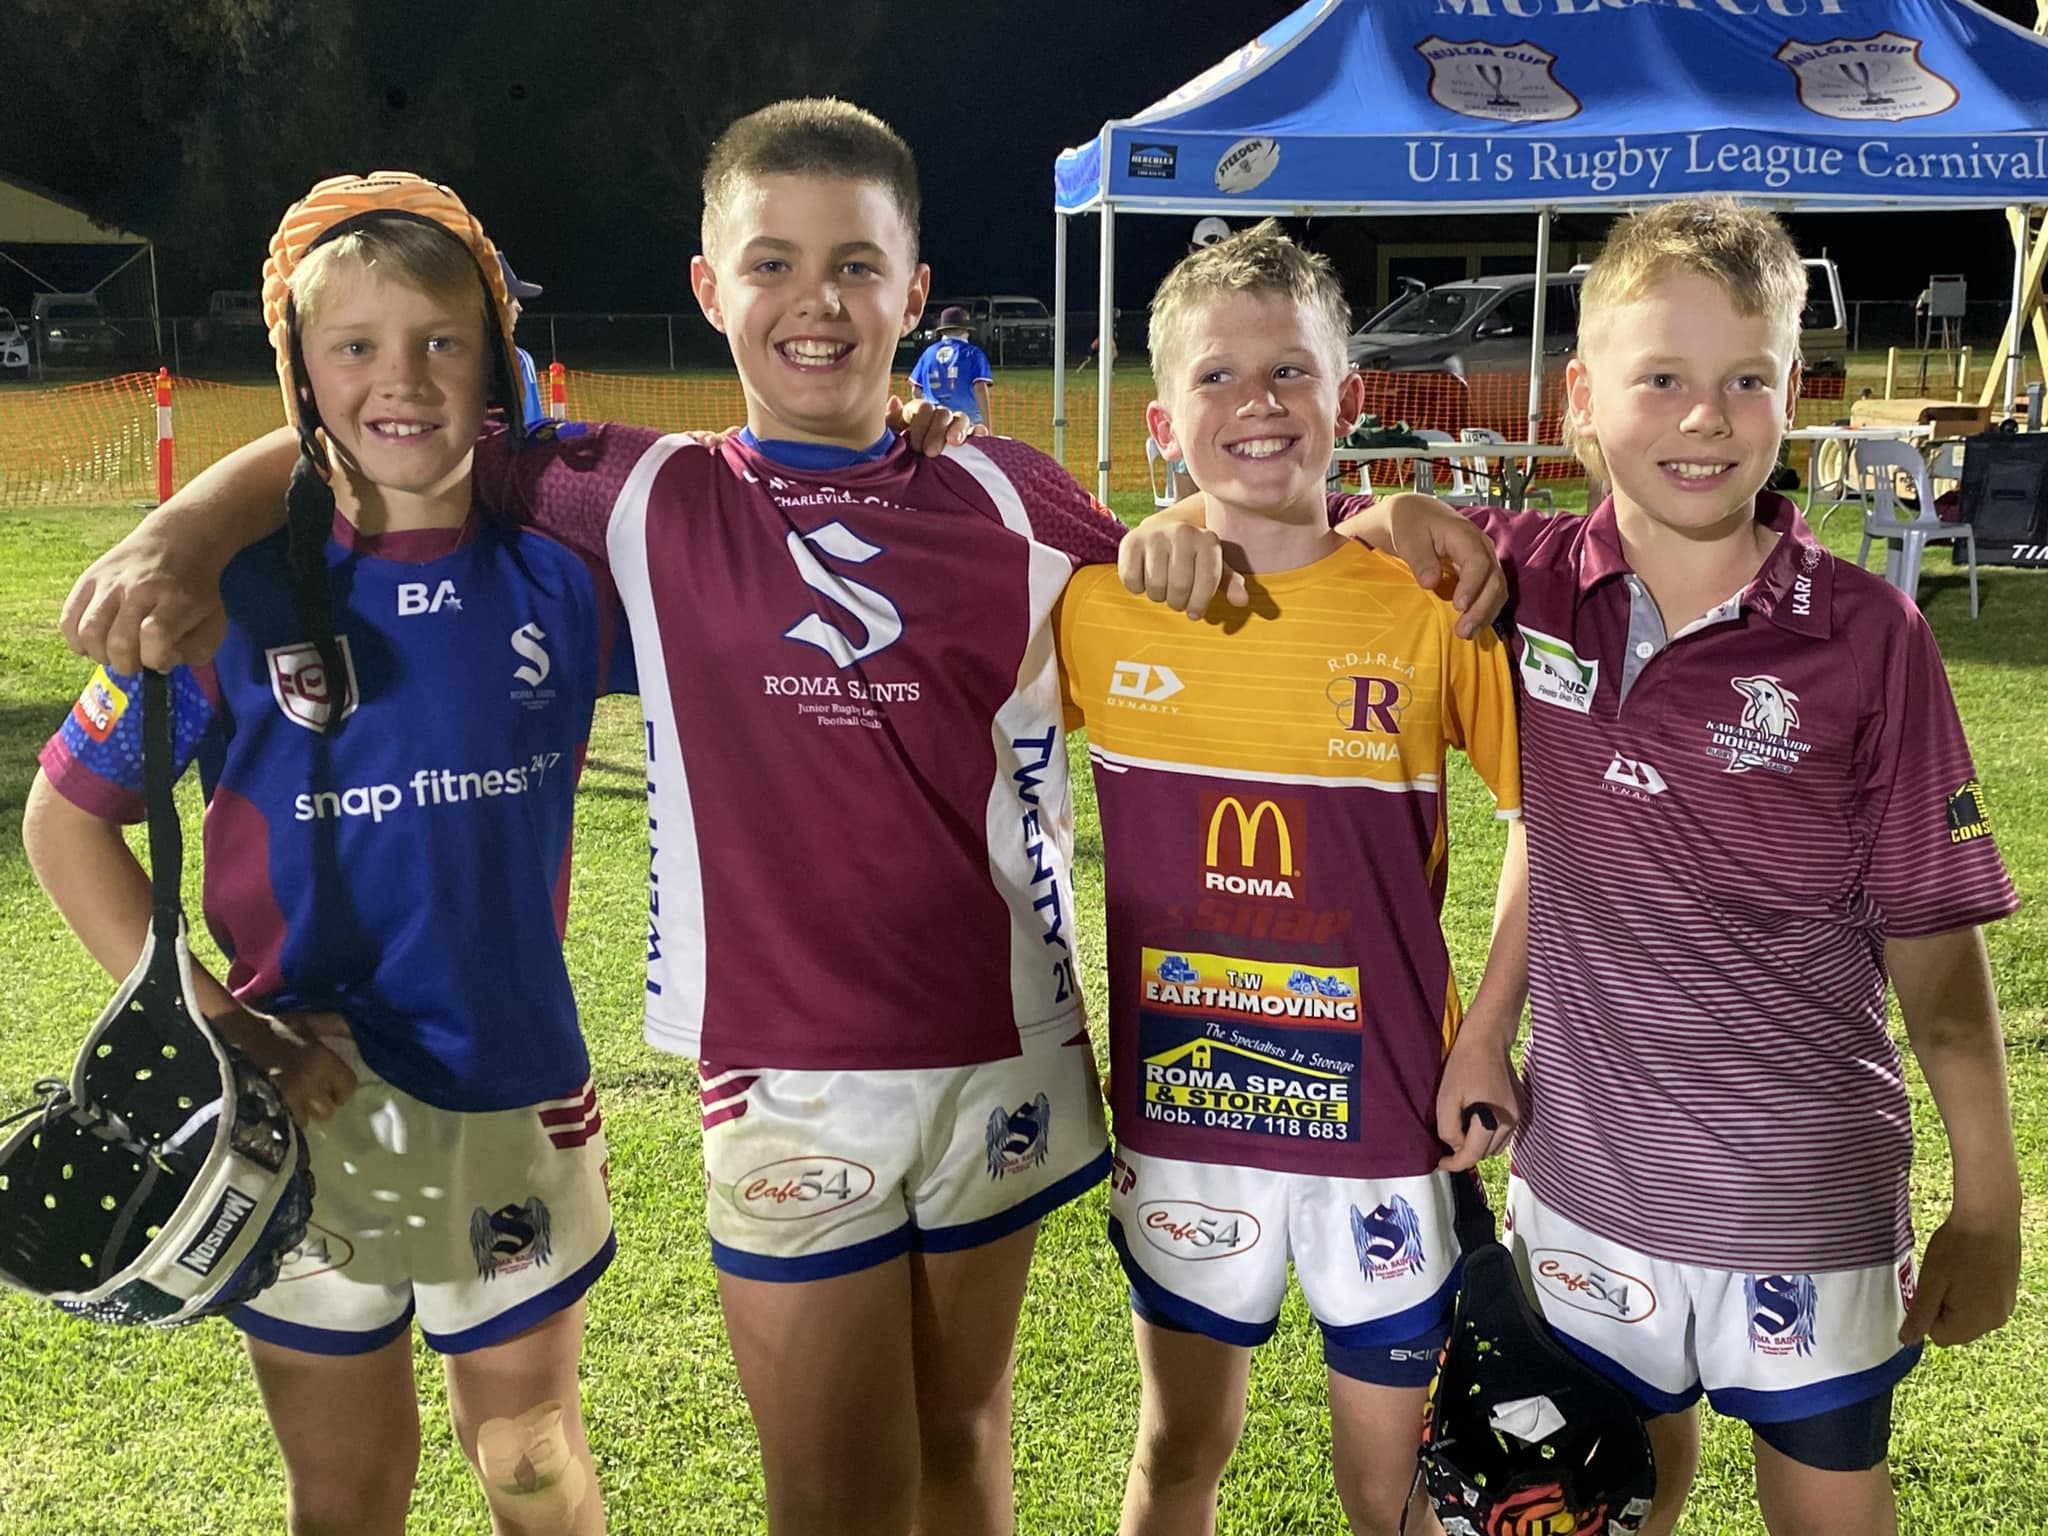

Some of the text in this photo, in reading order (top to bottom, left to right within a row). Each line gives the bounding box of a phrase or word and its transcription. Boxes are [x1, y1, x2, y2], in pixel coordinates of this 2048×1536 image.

[1427, 46, 1548, 65] MULGA CUP
[1787, 43, 1912, 66] MULGA CUP
[1219, 140, 1263, 177] STEEDEN
[1528, 137, 1672, 191] Rugby
[1684, 134, 1843, 187] League
[1857, 137, 2048, 179] Carnival
[1792, 573, 1812, 615] KARI
[764, 676, 842, 697] ROMA
[798, 703, 829, 714] Junior
[818, 716, 859, 726] Football
[1344, 675, 1401, 734] R
[1328, 738, 1401, 761] ROMA
[1712, 732, 1800, 763] DOLPHINS
[1766, 735, 1812, 753] JUNIOR
[294, 765, 528, 823] snap fitness
[1012, 726, 1067, 950] TWENTY
[1205, 872, 1295, 899] ROMA
[1146, 981, 1356, 1021] EARTHMOVING
[1206, 1022, 1354, 1075] The Specialists In Storage
[1146, 1064, 1348, 1101] ROMA SPACE
[1155, 1086, 1339, 1120] & STORAGE
[1145, 1103, 1348, 1140] Mob. 0427 118 683
[797, 1167, 851, 1201] 54
[181, 1190, 254, 1273] MADISON
[1146, 1211, 1241, 1248] Cafe 54
[1538, 1260, 1590, 1291] Cafe
